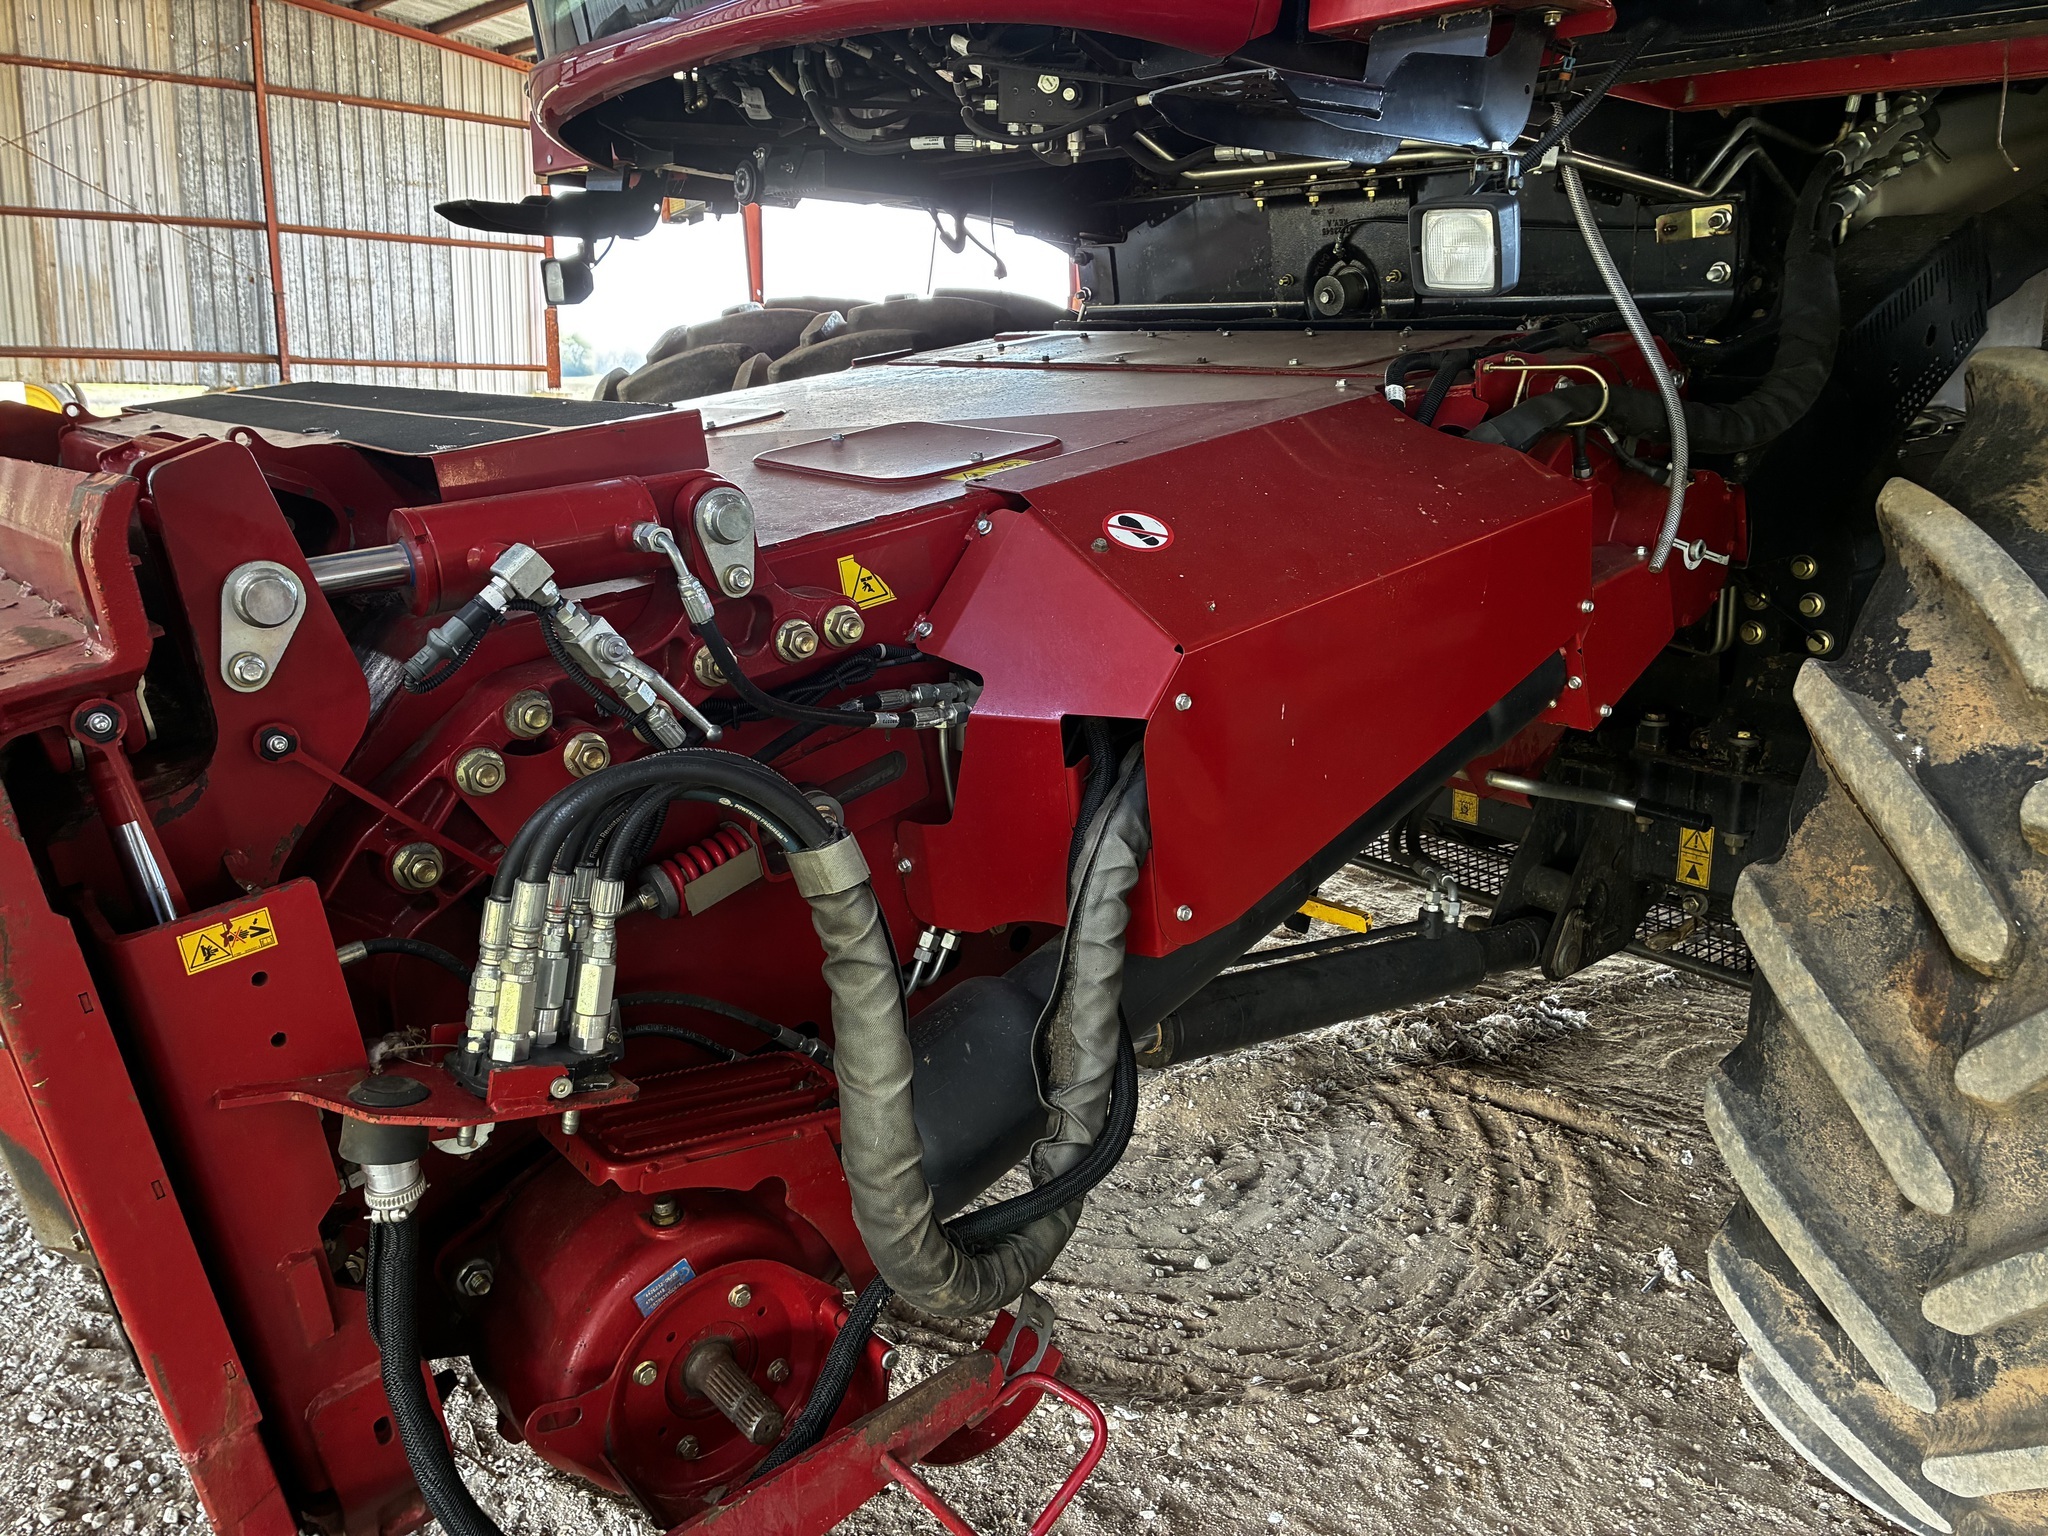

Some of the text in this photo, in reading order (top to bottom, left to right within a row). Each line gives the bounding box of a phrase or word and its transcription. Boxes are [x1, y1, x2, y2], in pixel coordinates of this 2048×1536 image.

[734, 803, 761, 821] POWERING
[589, 813, 626, 859] Flame Resistant
